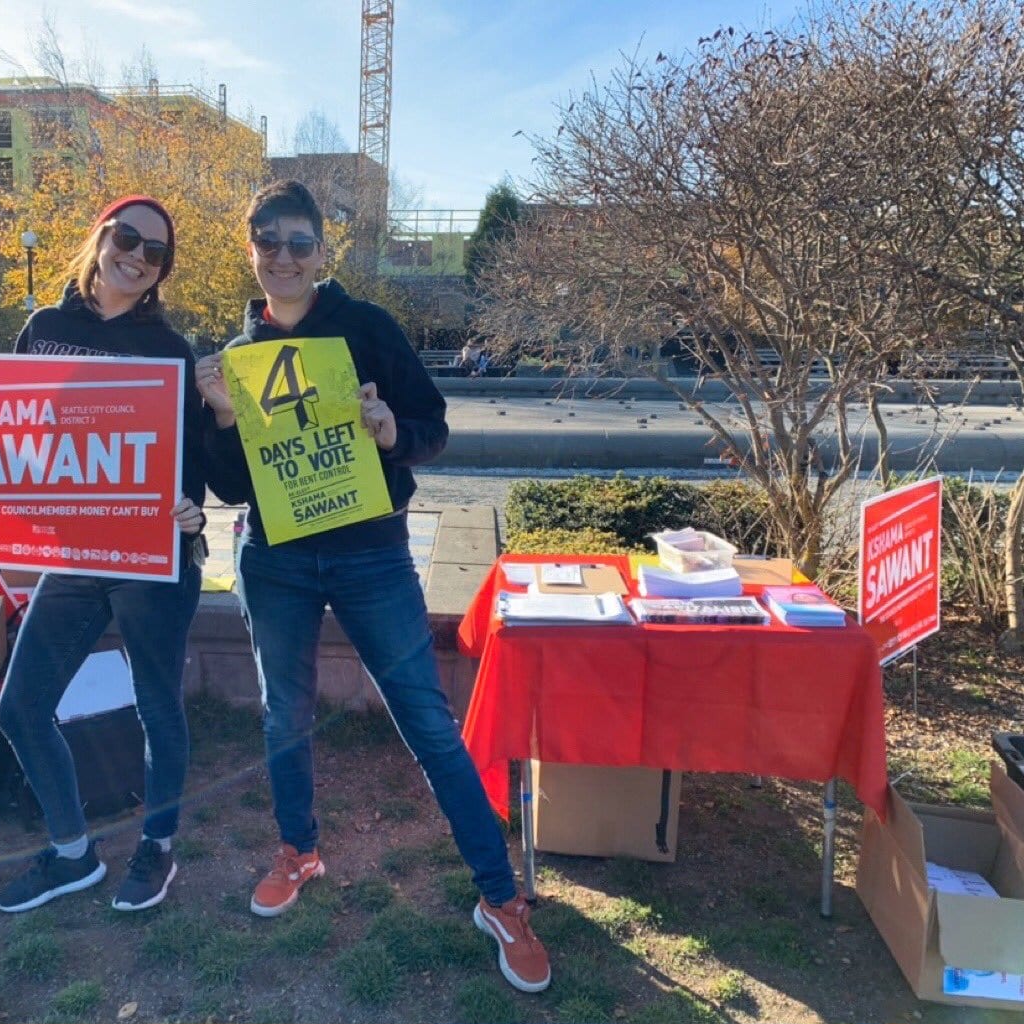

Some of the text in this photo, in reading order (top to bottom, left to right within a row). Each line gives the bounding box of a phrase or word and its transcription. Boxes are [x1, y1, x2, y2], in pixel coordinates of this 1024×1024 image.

[260, 345, 319, 431] 4
[61, 405, 134, 414] SEATTLE CITY COUNCIL
[61, 416, 89, 424] DISTRICT
[259, 421, 355, 465] DAYS LEFT
[273, 444, 355, 481] TO VOTE
[284, 465, 351, 490] FOR RENT CONTROL
[2, 506, 76, 516] COUNCILMEMBER
[79, 506, 110, 516] MONEY
[112, 506, 138, 516] CAN'T
[141, 507, 159, 517] BUY
[291, 492, 326, 508] KSHAMA
[293, 490, 357, 522] SAWANT
[867, 523, 903, 562] KSHAMA
[866, 529, 933, 609] SAWANT
